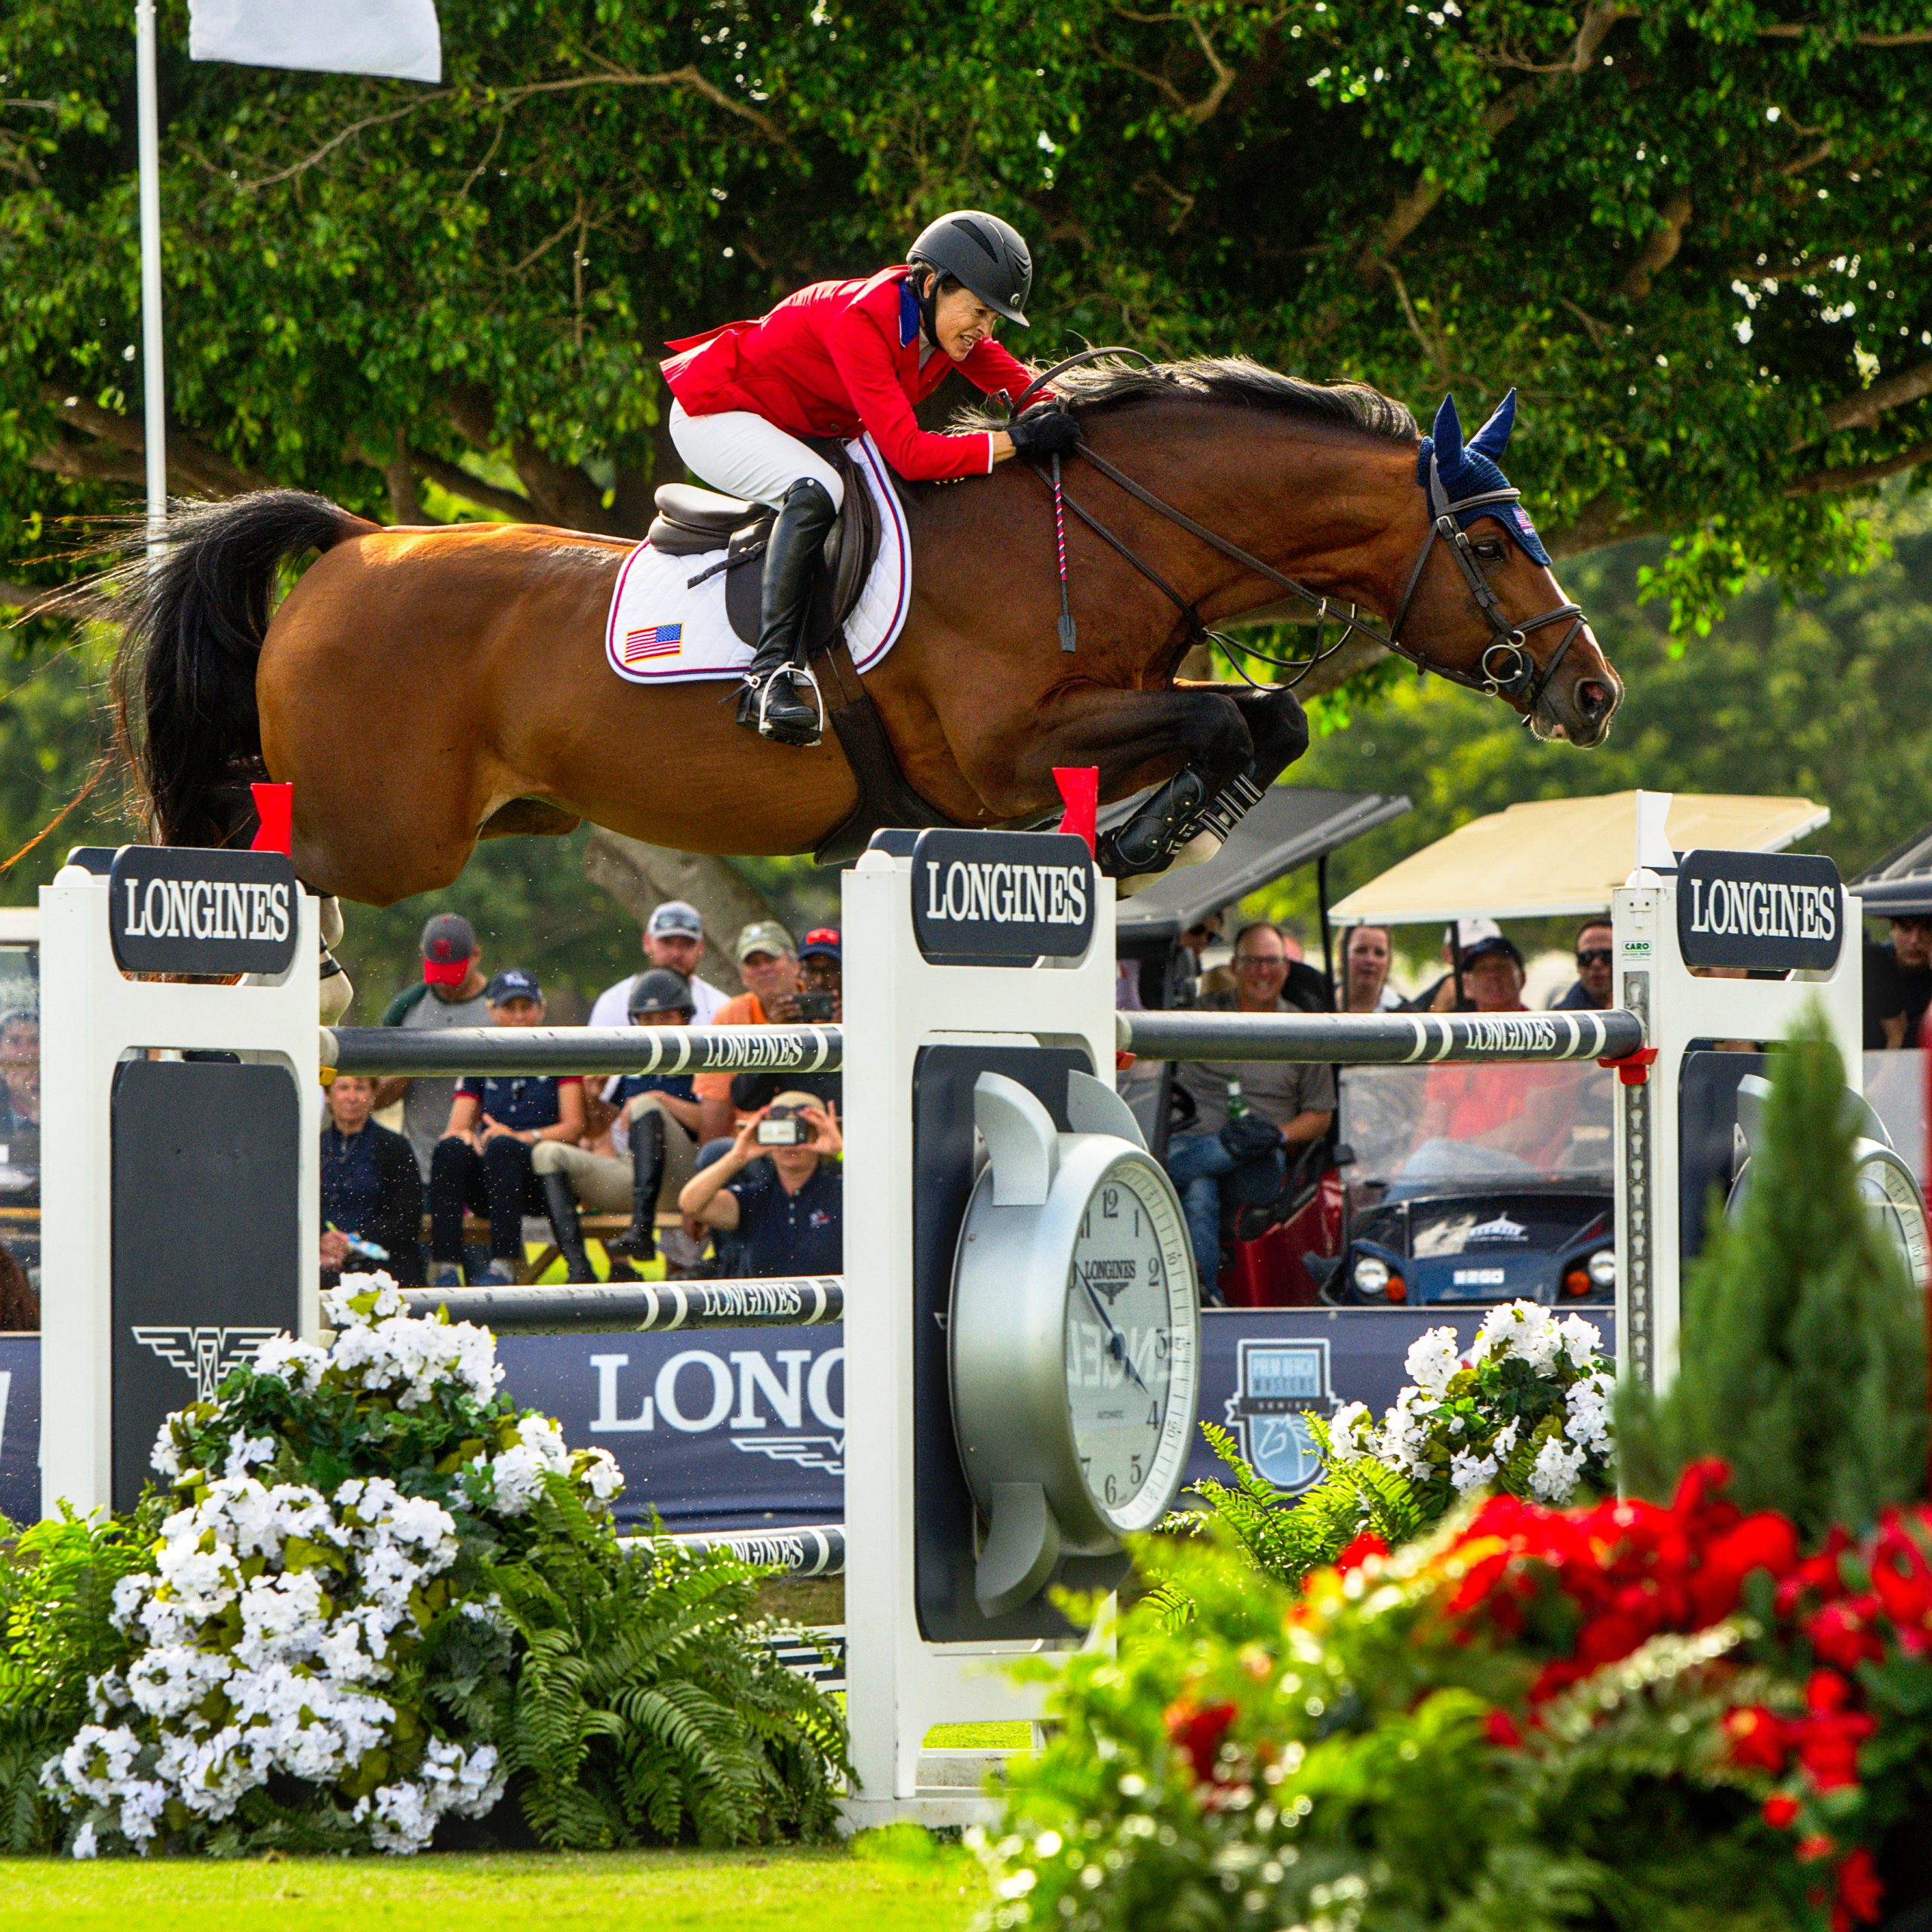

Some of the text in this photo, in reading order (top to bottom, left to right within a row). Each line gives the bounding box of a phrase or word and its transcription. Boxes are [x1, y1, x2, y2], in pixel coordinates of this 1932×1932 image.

[926, 861, 1087, 925] LONGINES
[125, 878, 290, 942] LONGINES
[1690, 878, 1835, 941] LONGINES
[702, 1034, 803, 1066] LONGINES
[1460, 1017, 1557, 1051] LONGINES
[1103, 1189, 1118, 1218] 12
[1134, 1208, 1140, 1238] 1
[1084, 1259, 1136, 1280] LONGINES
[1148, 1257, 1160, 1287] 2
[699, 1282, 801, 1316] LONGINES
[1146, 1400, 1160, 1430] 4
[1130, 1454, 1143, 1485] 5
[1104, 1474, 1117, 1506] 6
